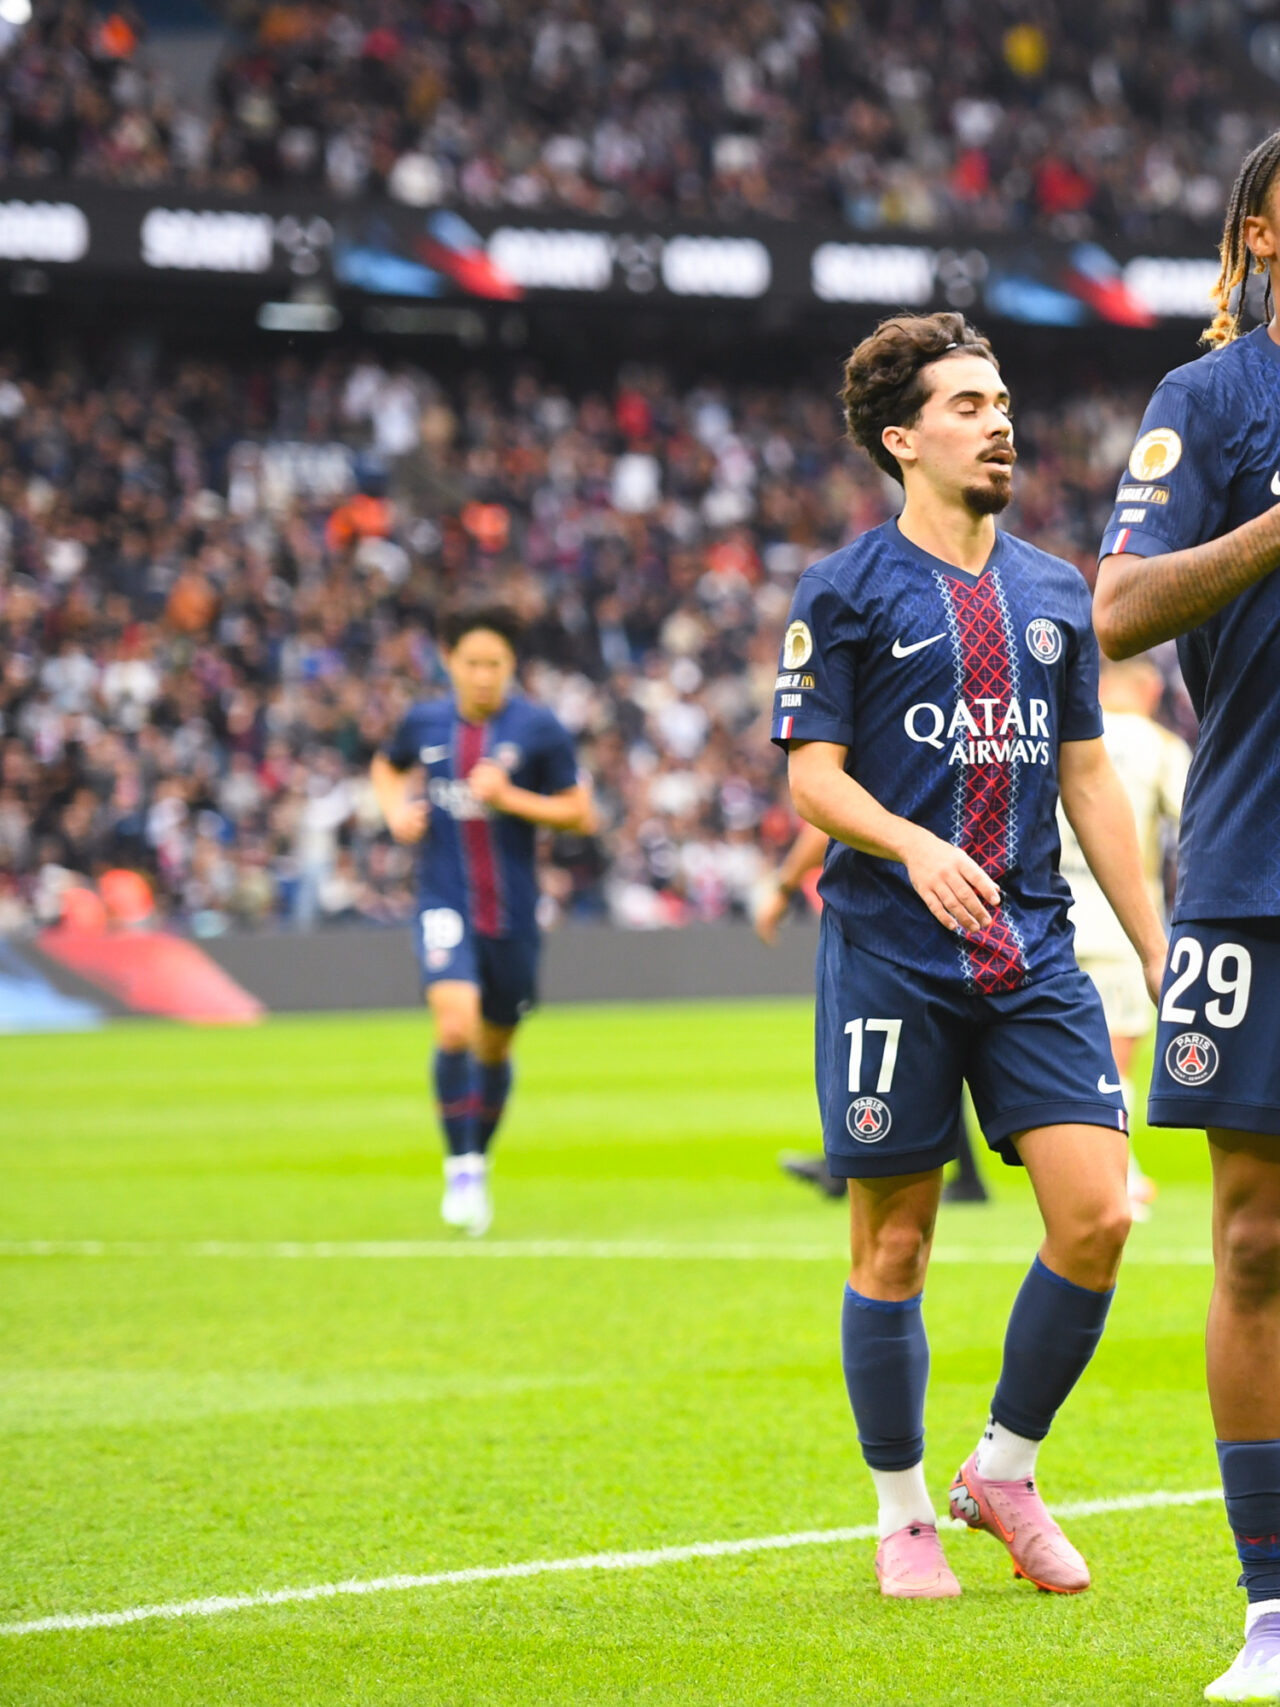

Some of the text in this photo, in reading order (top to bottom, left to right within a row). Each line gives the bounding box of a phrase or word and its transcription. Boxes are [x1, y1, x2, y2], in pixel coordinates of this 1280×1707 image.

[904, 698, 1049, 749] QATAR
[948, 740, 1049, 765] AIRWAYS
[1160, 937, 1252, 1029] 29
[843, 1018, 902, 1093] 17
[1176, 1035, 1211, 1050] PARIS
[853, 1099, 884, 1112] PARIS
